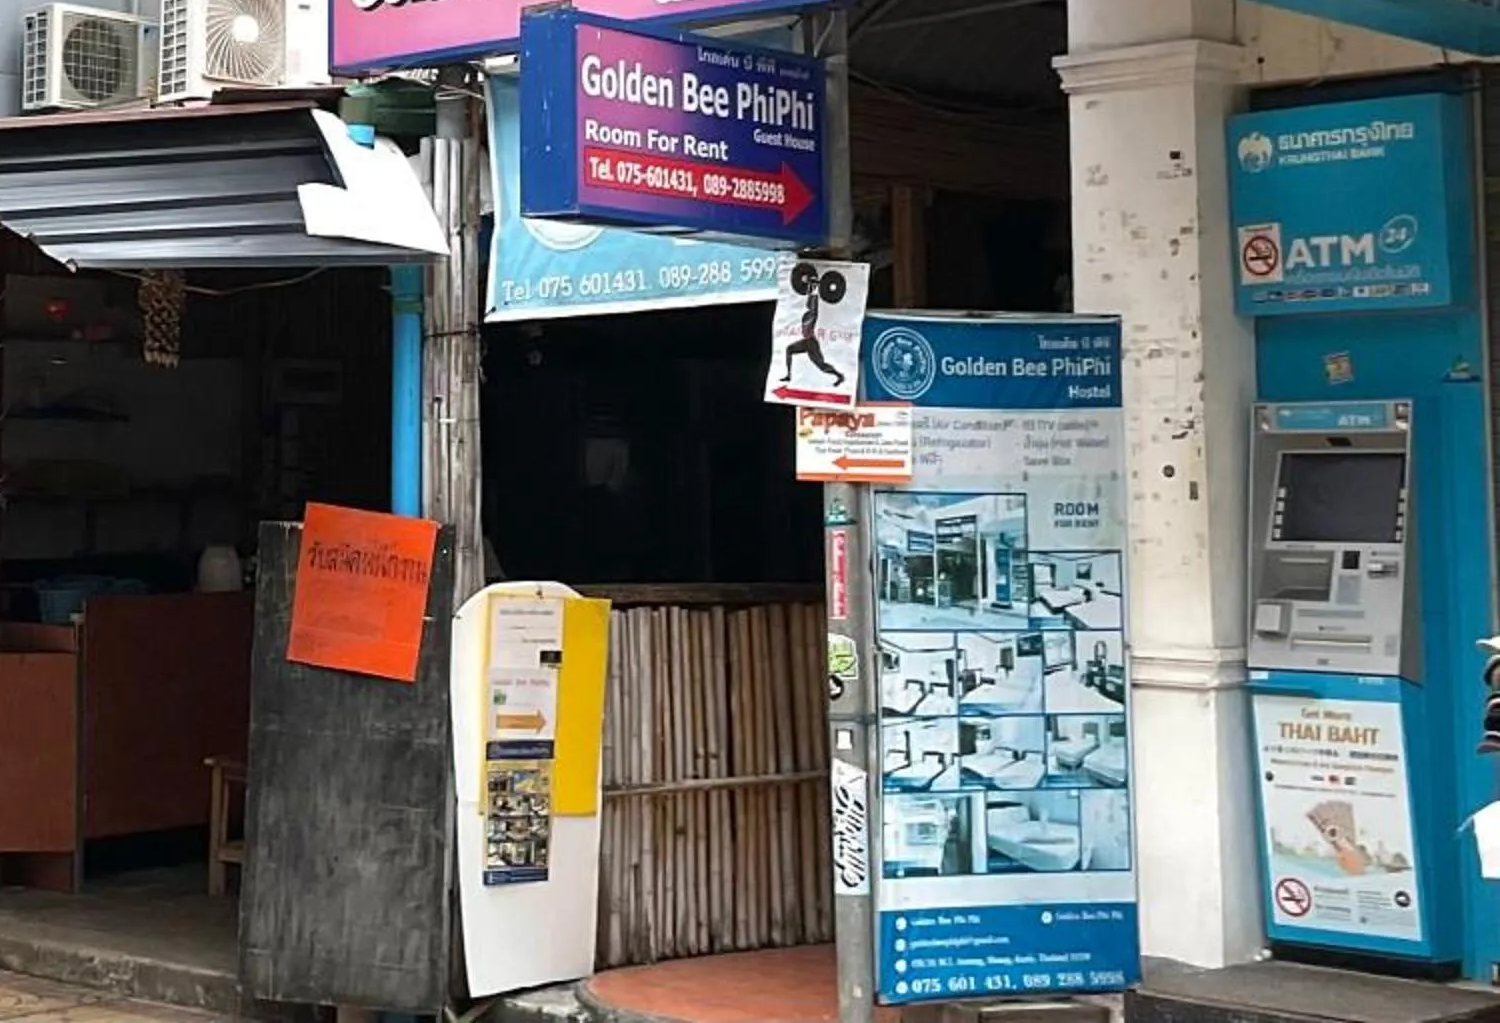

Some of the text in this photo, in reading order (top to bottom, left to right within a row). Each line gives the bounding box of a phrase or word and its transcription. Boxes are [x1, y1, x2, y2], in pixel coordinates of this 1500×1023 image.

[581, 53, 815, 132] Golden Bee PhiPhi
[584, 118, 729, 162] Room For Rent
[753, 128, 816, 152] Guest House
[1278, 146, 1386, 166] KRUNGTHAI BANK
[589, 156, 614, 180] Tel.
[616, 161, 699, 198] 075-601431,
[1285, 232, 1376, 270] ATM
[537, 276, 574, 298] 075
[658, 260, 732, 289] 089-288
[739, 256, 778, 281] 599
[941, 355, 1007, 377] Golden
[1011, 358, 1048, 377] Bee
[1051, 355, 1112, 377] PhiPhi
[1067, 384, 1112, 399] Hostel
[1337, 414, 1371, 427] ATM
[1053, 501, 1100, 517] ROOM
[1278, 721, 1381, 746] THAI BAHT
[910, 978, 942, 994] 075
[947, 976, 977, 992] 601
